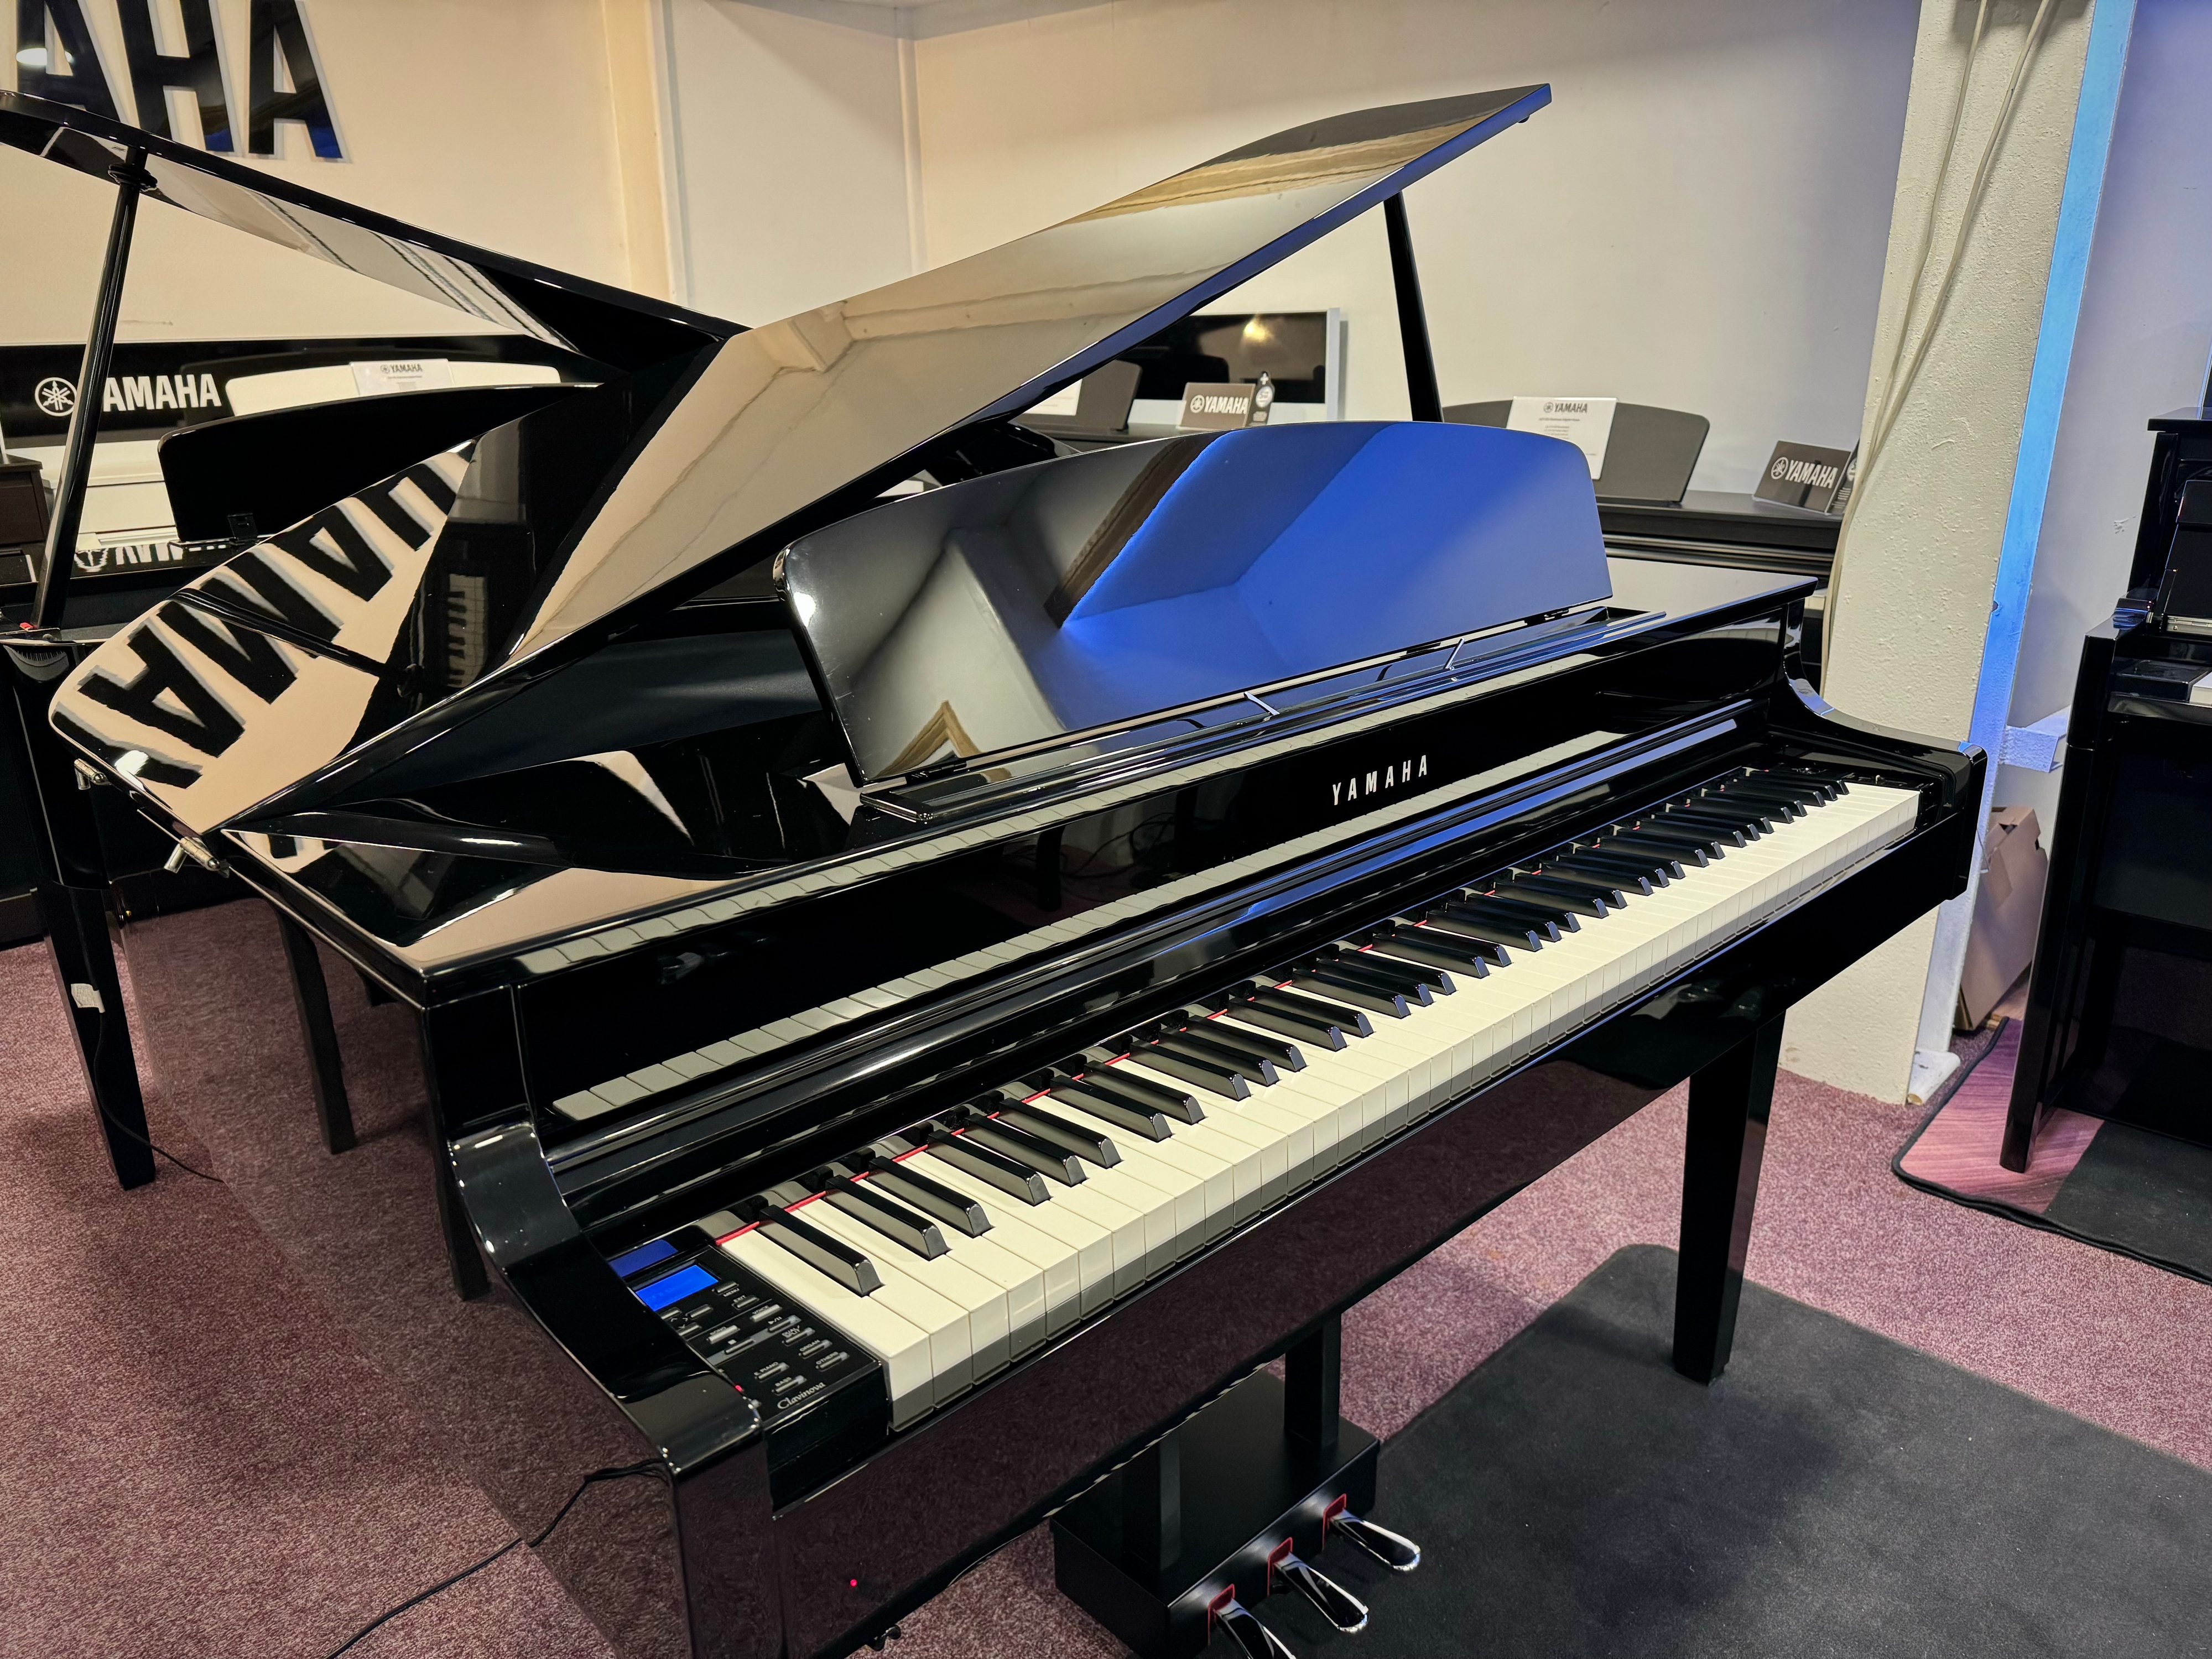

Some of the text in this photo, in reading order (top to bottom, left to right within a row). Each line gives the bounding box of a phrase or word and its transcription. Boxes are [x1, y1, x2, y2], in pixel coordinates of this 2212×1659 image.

[391, 363, 423, 373] YAMAHA
[103, 373, 222, 411] AMAHA
[1204, 395, 1249, 414] YAMAHA
[1554, 403, 1588, 413] YAMAHA
[1785, 460, 1838, 488] YAMAHA
[1333, 754, 1427, 806] YAMAHA
[723, 1288, 740, 1297] MENU
[799, 1339, 820, 1352] ORGAN
[777, 1382, 826, 1409] Clavinova
